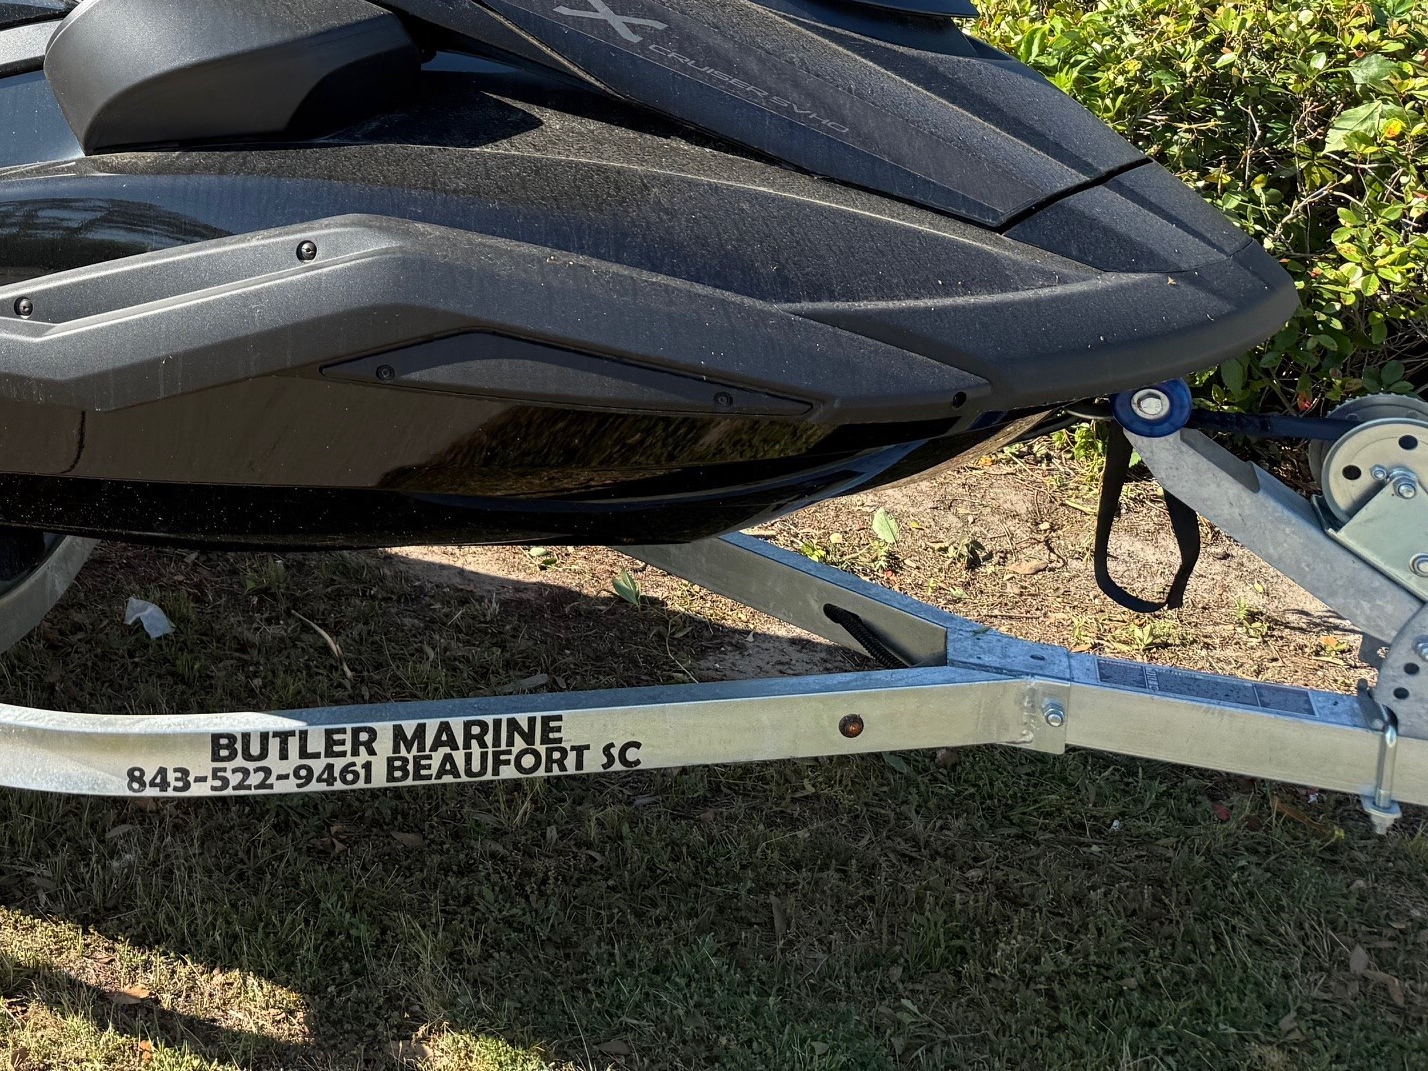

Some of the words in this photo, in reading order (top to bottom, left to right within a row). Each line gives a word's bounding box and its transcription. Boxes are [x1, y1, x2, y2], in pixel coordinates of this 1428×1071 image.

[648, 43, 770, 97] CRUISER
[210, 725, 378, 764] BUTLER
[392, 714, 564, 755] MARINE
[126, 759, 373, 794] 843-522-9461
[385, 743, 591, 784] BEAUFORT
[601, 740, 642, 772] SC
